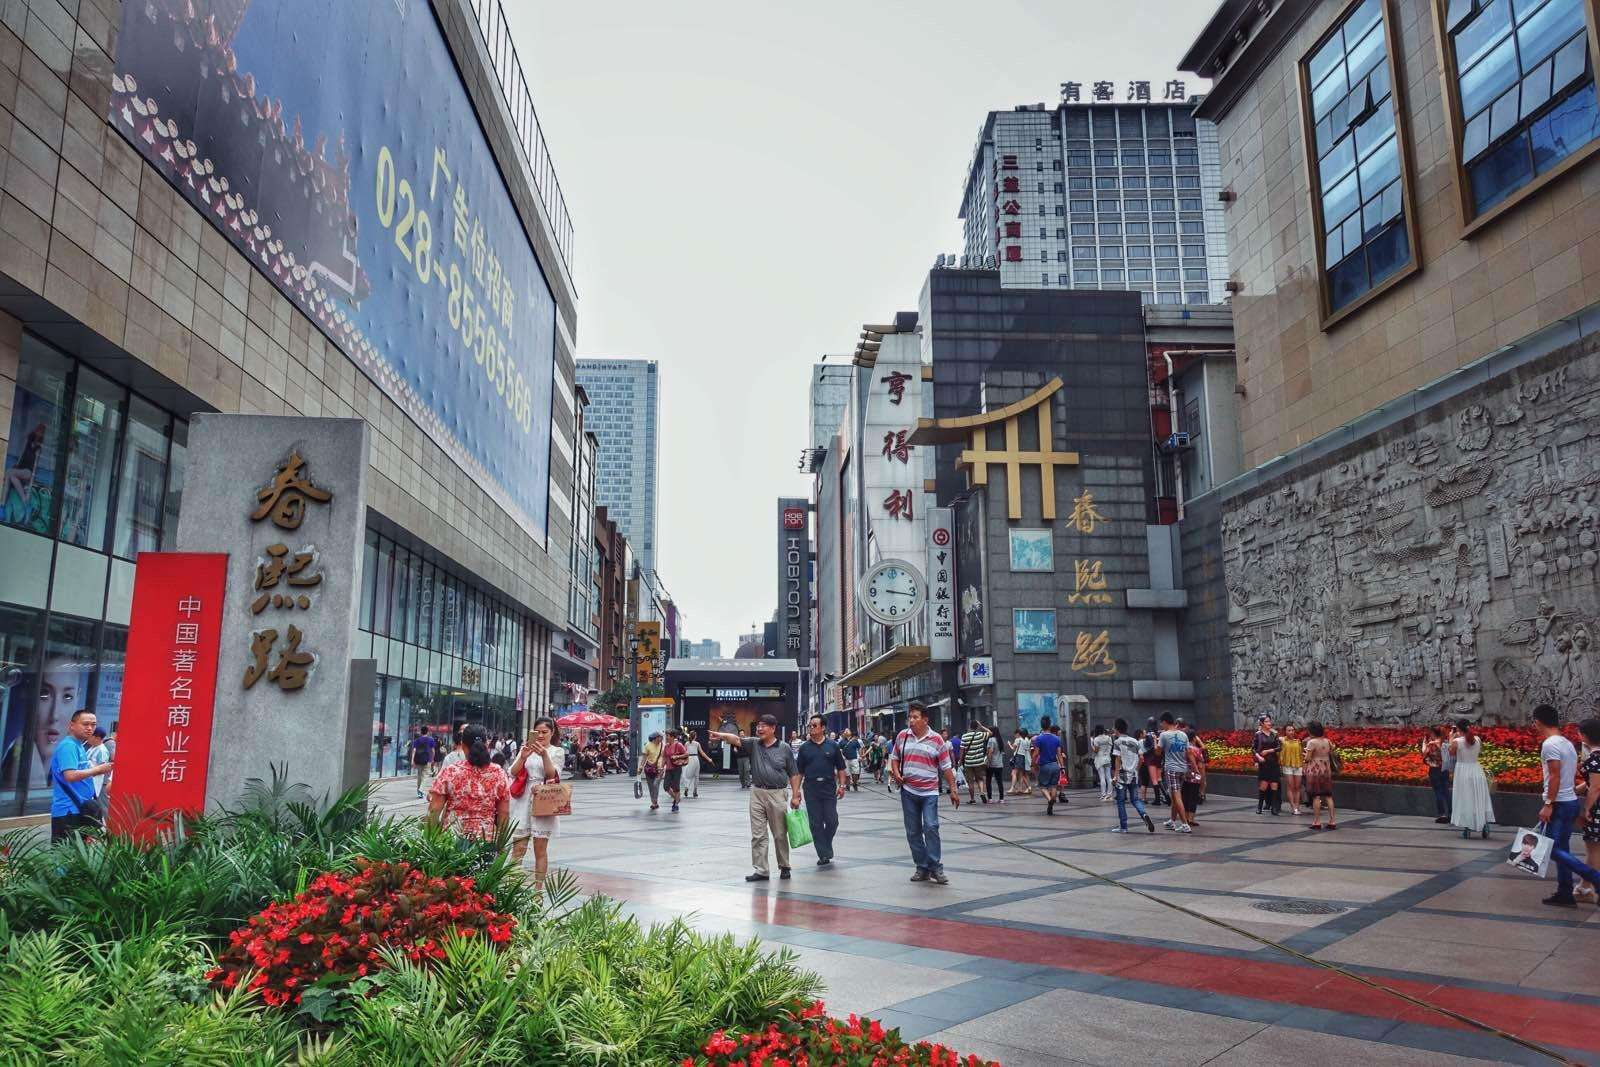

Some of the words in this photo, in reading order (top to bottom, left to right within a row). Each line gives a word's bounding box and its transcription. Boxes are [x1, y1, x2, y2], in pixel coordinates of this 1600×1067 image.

[1060, 80, 1186, 101] 有客酒店
[376, 146, 531, 434] 028-85565566
[429, 146, 516, 341] 广告位招商
[881, 371, 914, 521] 亨得利
[244, 452, 332, 694] 春熙路
[870, 587, 877, 597] 9
[890, 605, 897, 616] 6
[909, 587, 916, 597] 3
[1066, 490, 1118, 677] 春熙路
[160, 595, 201, 783] 中国著名商业街
[716, 689, 748, 697] RADO
